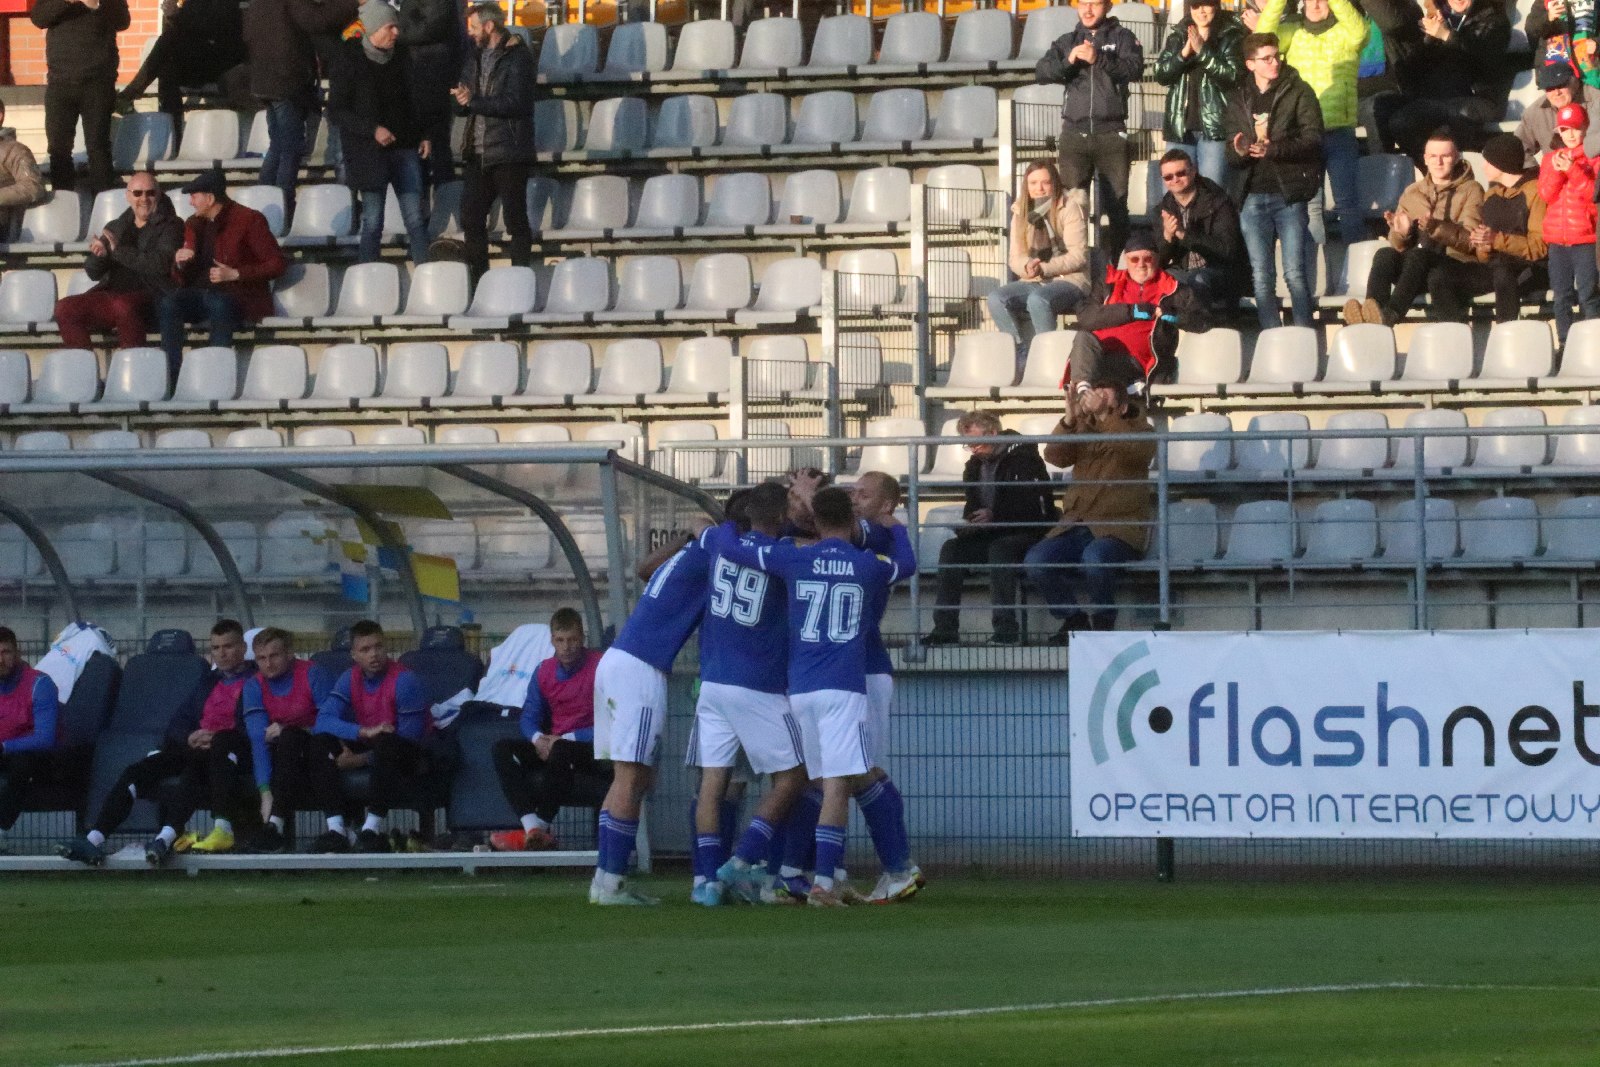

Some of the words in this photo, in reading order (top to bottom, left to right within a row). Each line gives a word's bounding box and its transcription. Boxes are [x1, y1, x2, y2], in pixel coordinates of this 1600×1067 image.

[711, 554, 769, 626] 59
[812, 557, 855, 576] ŚLIWA
[796, 580, 864, 643] 70
[1188, 680, 1600, 768] flashnet
[1089, 792, 1295, 823] OPERATOR
[1308, 792, 1600, 823] INTERNETOWY
